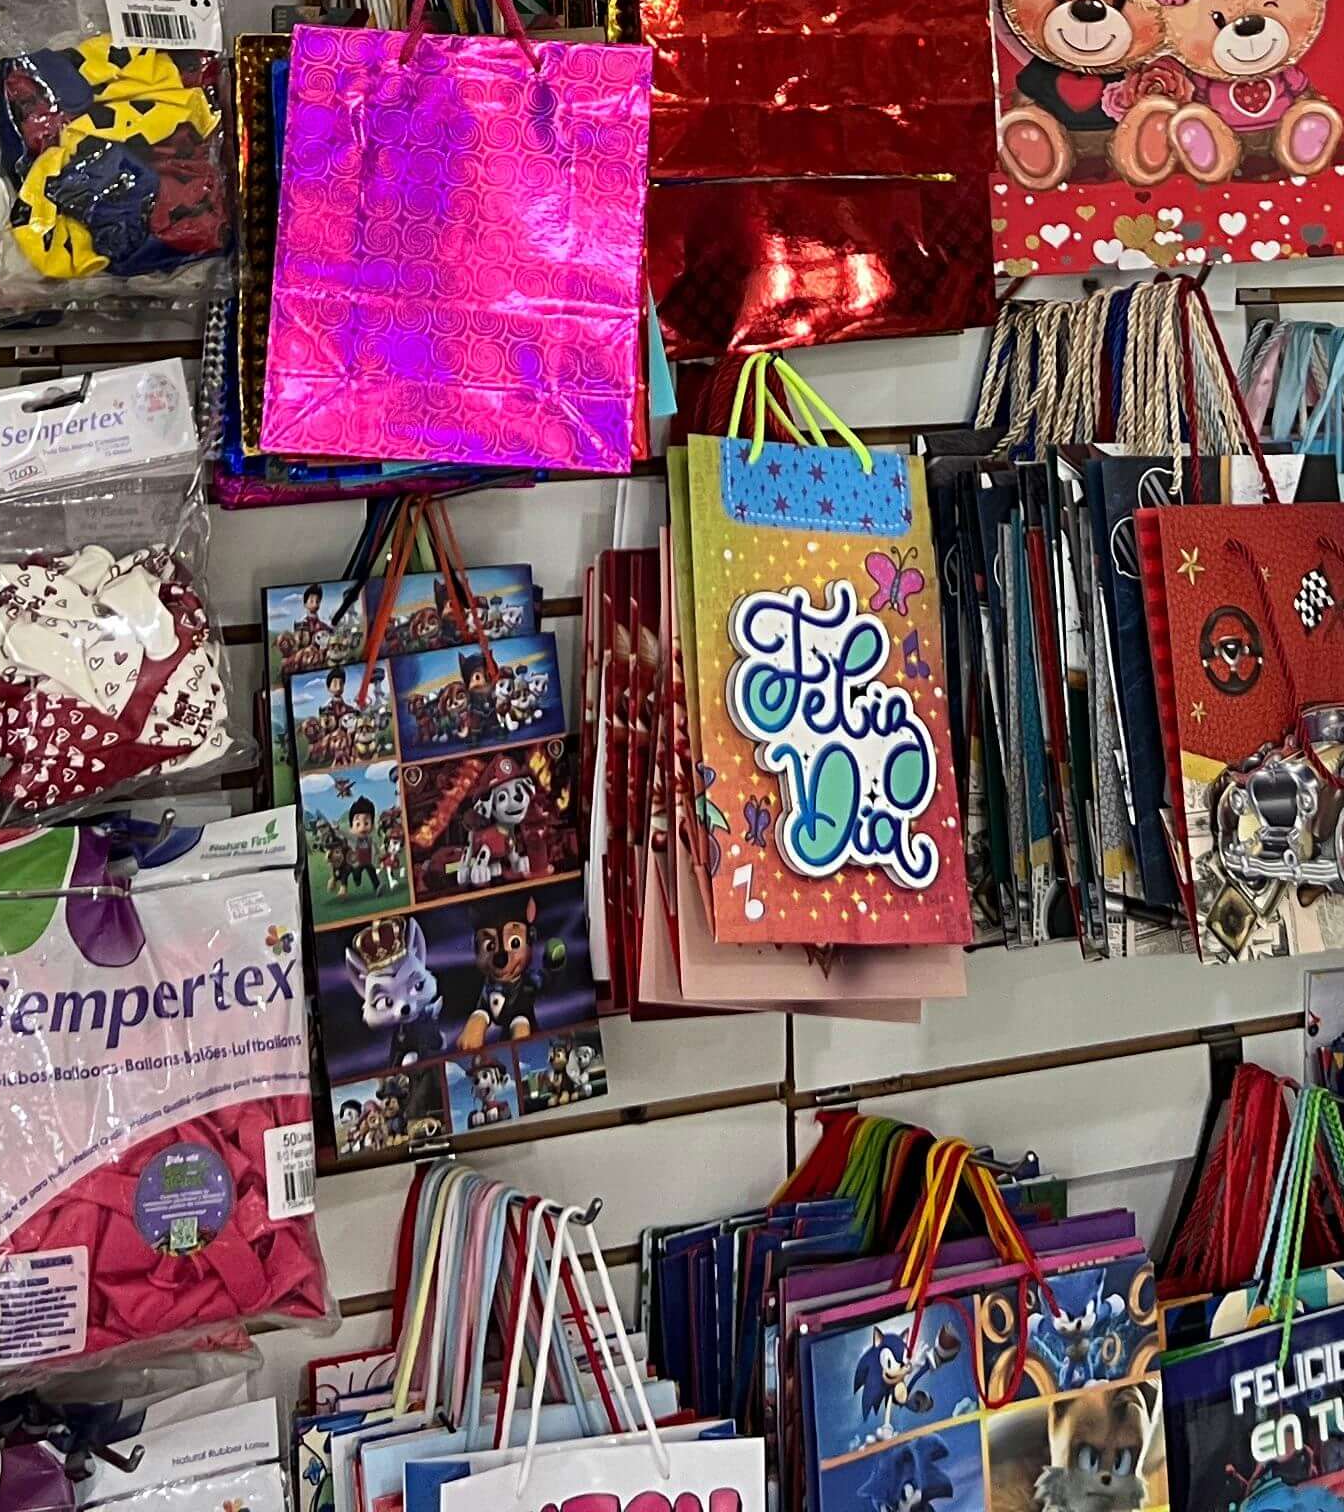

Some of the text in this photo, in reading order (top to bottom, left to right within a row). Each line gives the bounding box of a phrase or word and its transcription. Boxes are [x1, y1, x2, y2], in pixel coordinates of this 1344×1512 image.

[0, 408, 127, 447] Sempertex
[742, 588, 930, 811] Feliz
[232, 1031, 303, 1058] Luftballons
[282, 1131, 299, 1148] 50
[1250, 1413, 1305, 1464] EN
